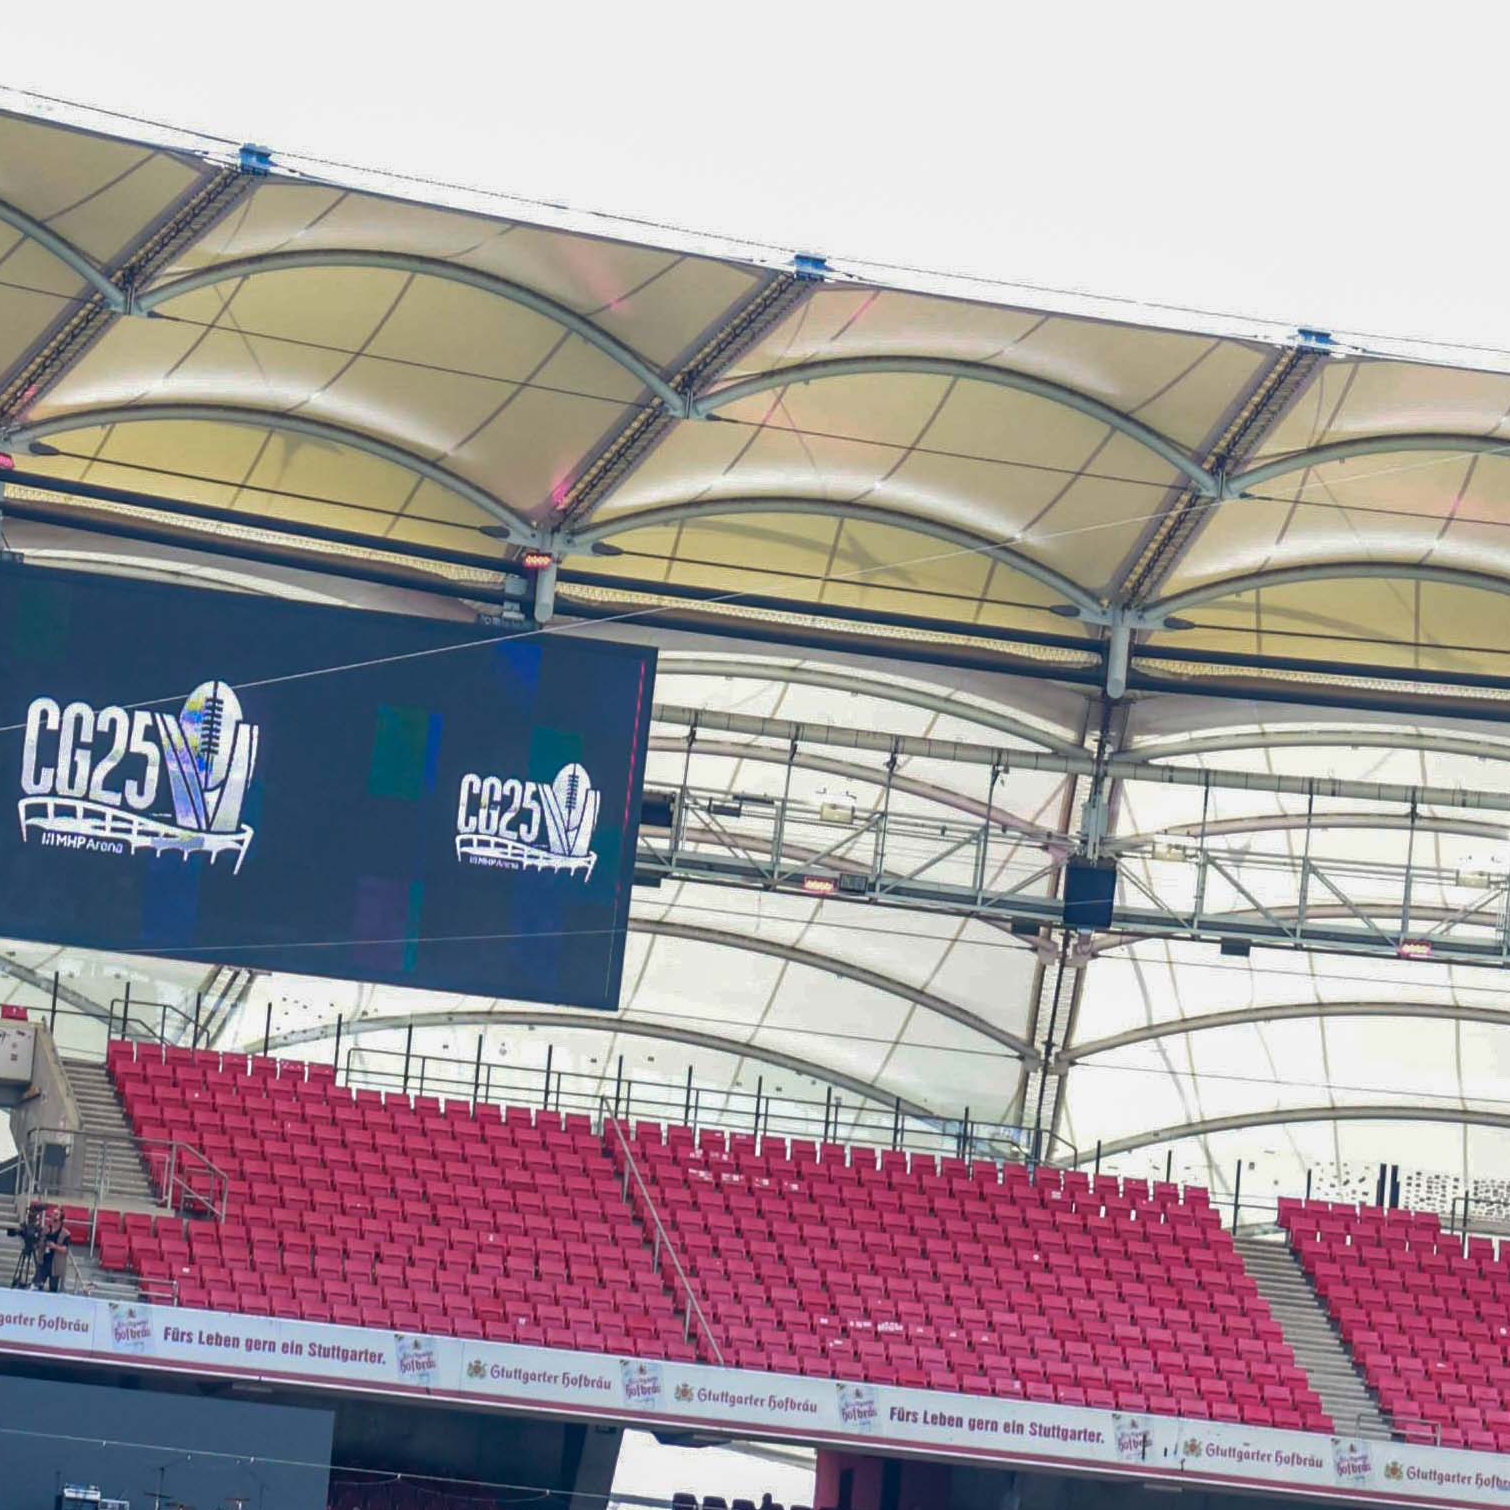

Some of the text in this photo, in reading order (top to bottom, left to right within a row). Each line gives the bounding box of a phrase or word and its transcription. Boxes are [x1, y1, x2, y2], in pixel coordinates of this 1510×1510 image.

[21, 697, 160, 809] CG25
[457, 774, 540, 842] CG25
[56, 836, 123, 853] MHP Arena
[163, 1326, 194, 1345] Fürs
[198, 1330, 240, 1350] Leben
[245, 1337, 276, 1356] gern
[281, 1340, 303, 1356] ein
[308, 1341, 386, 1366] Stuttgarter.
[889, 1406, 918, 1424] Fürs
[923, 1411, 964, 1430] Leben
[968, 1416, 998, 1434] gern
[1003, 1419, 1024, 1434] ein
[1028, 1421, 1105, 1445] Stuttgarter.
